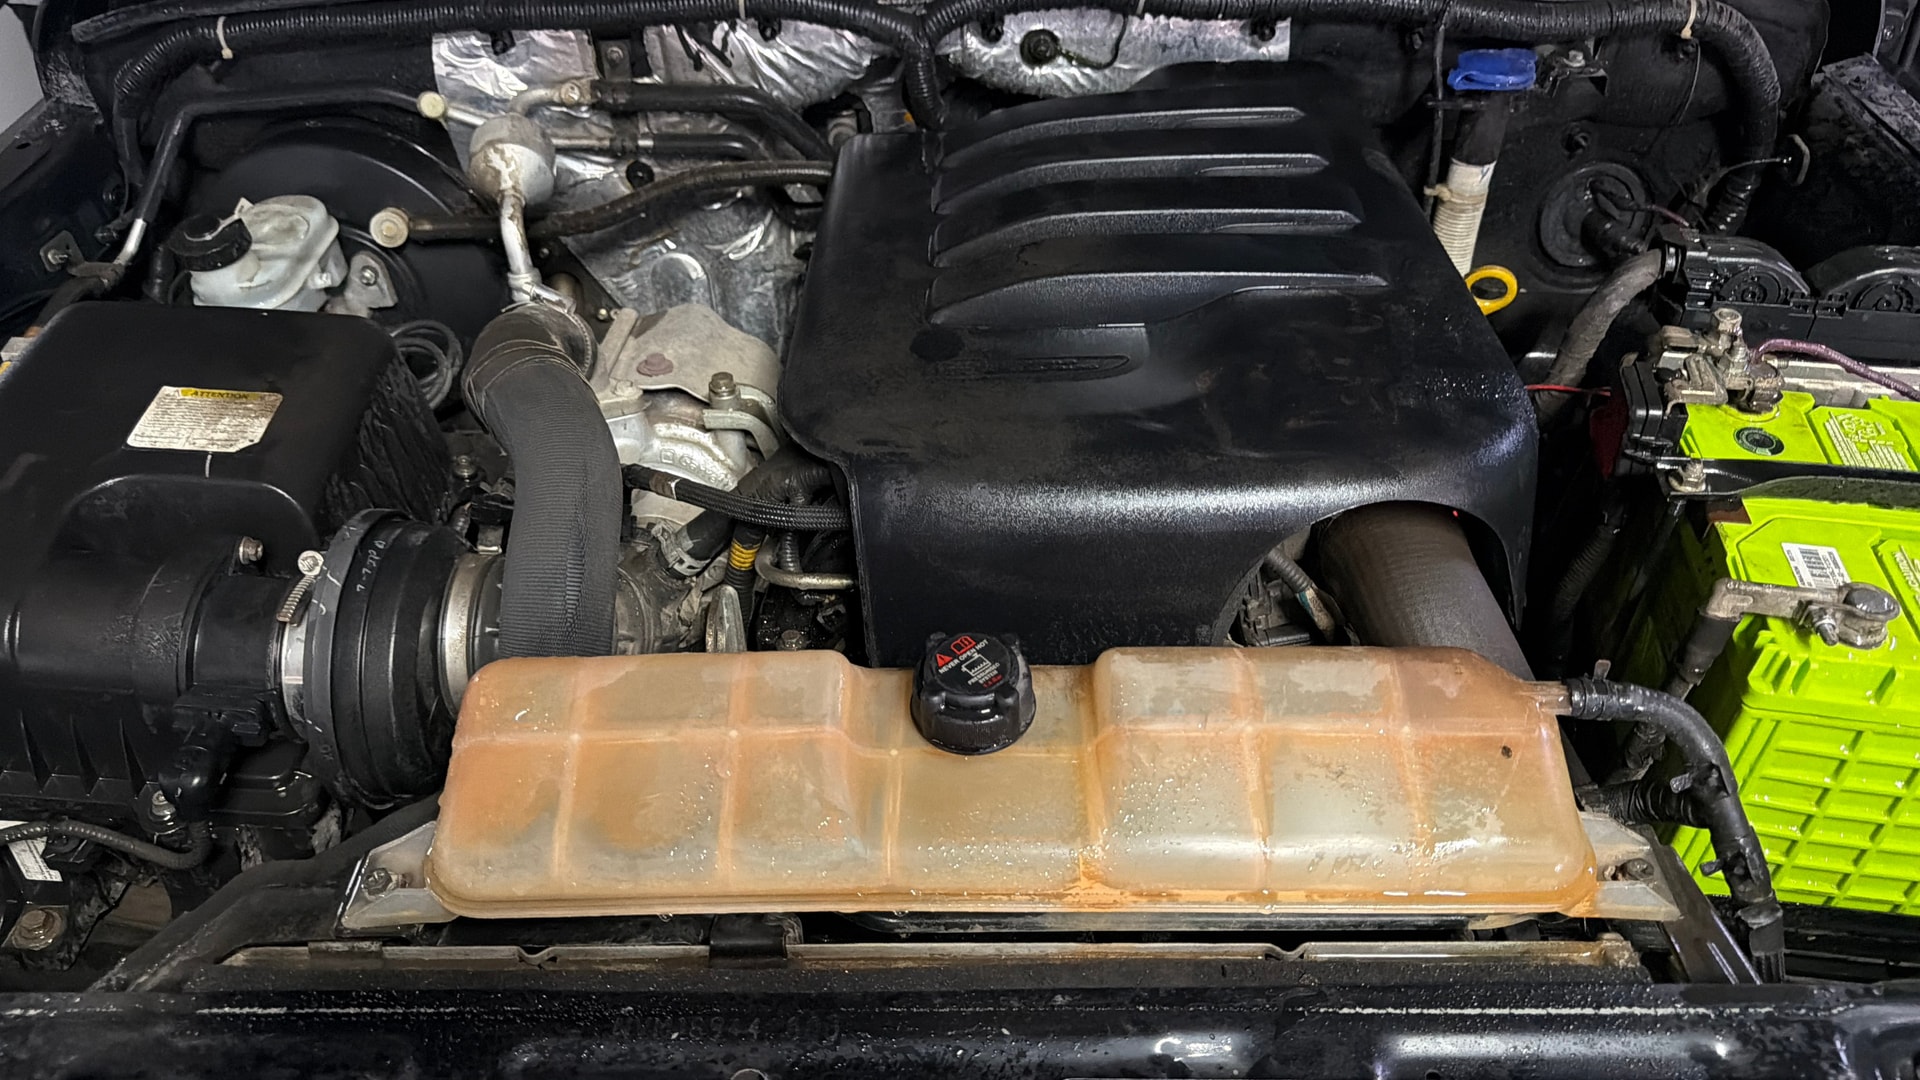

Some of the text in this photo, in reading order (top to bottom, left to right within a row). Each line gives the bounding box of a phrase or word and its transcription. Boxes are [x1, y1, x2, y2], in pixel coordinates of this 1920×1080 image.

[192, 390, 249, 399] ATTENTION
[938, 639, 988, 673] NEVER OPEN HOT
[979, 670, 998, 683] SYSTEM
